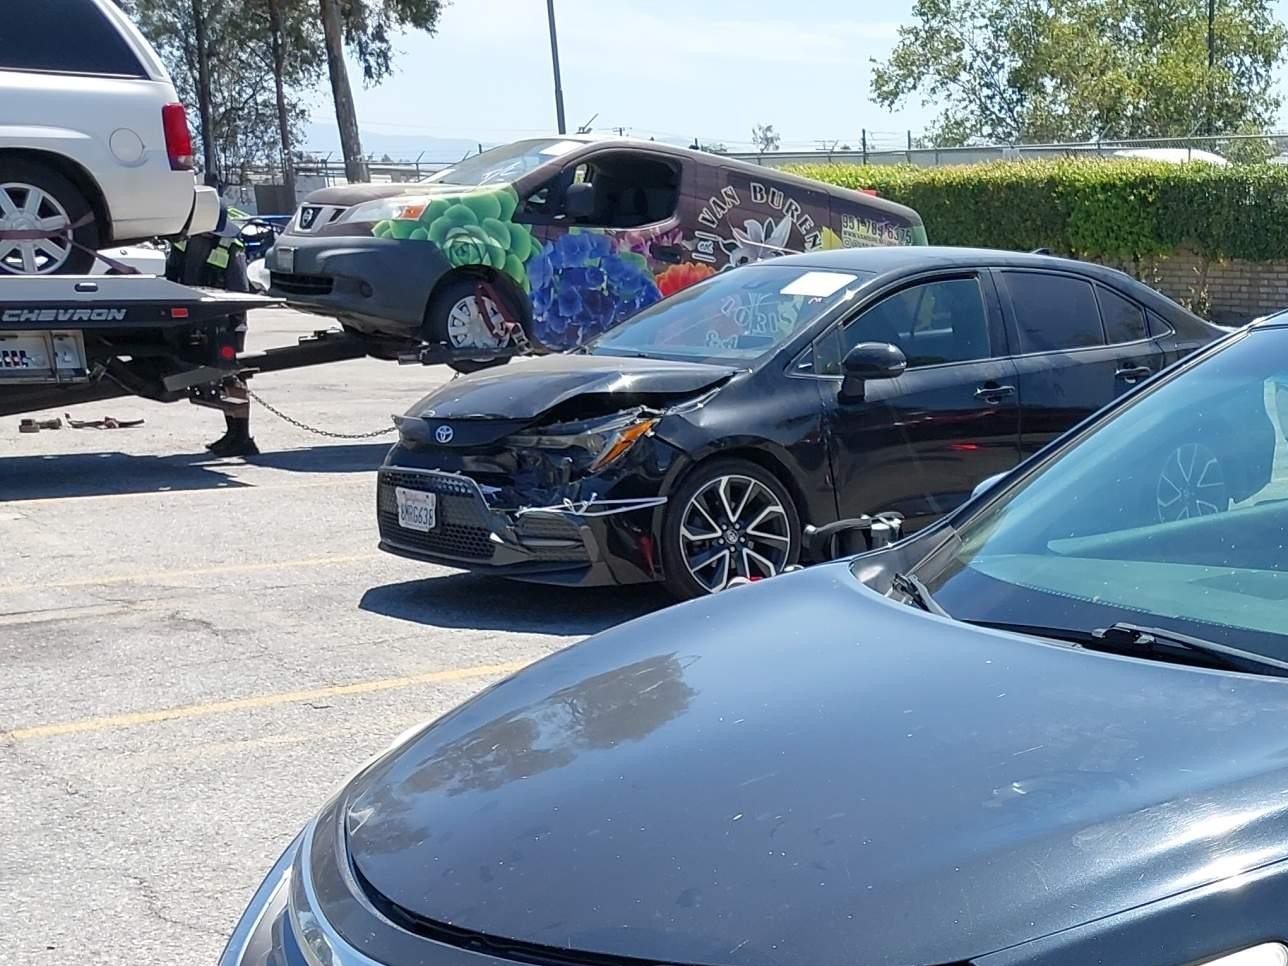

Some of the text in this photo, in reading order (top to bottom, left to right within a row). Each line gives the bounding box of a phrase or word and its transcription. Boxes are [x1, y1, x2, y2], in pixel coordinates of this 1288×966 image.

[698, 185, 741, 229] VAN
[750, 182, 822, 252] BUREN
[2, 308, 127, 322] CHEVRON
